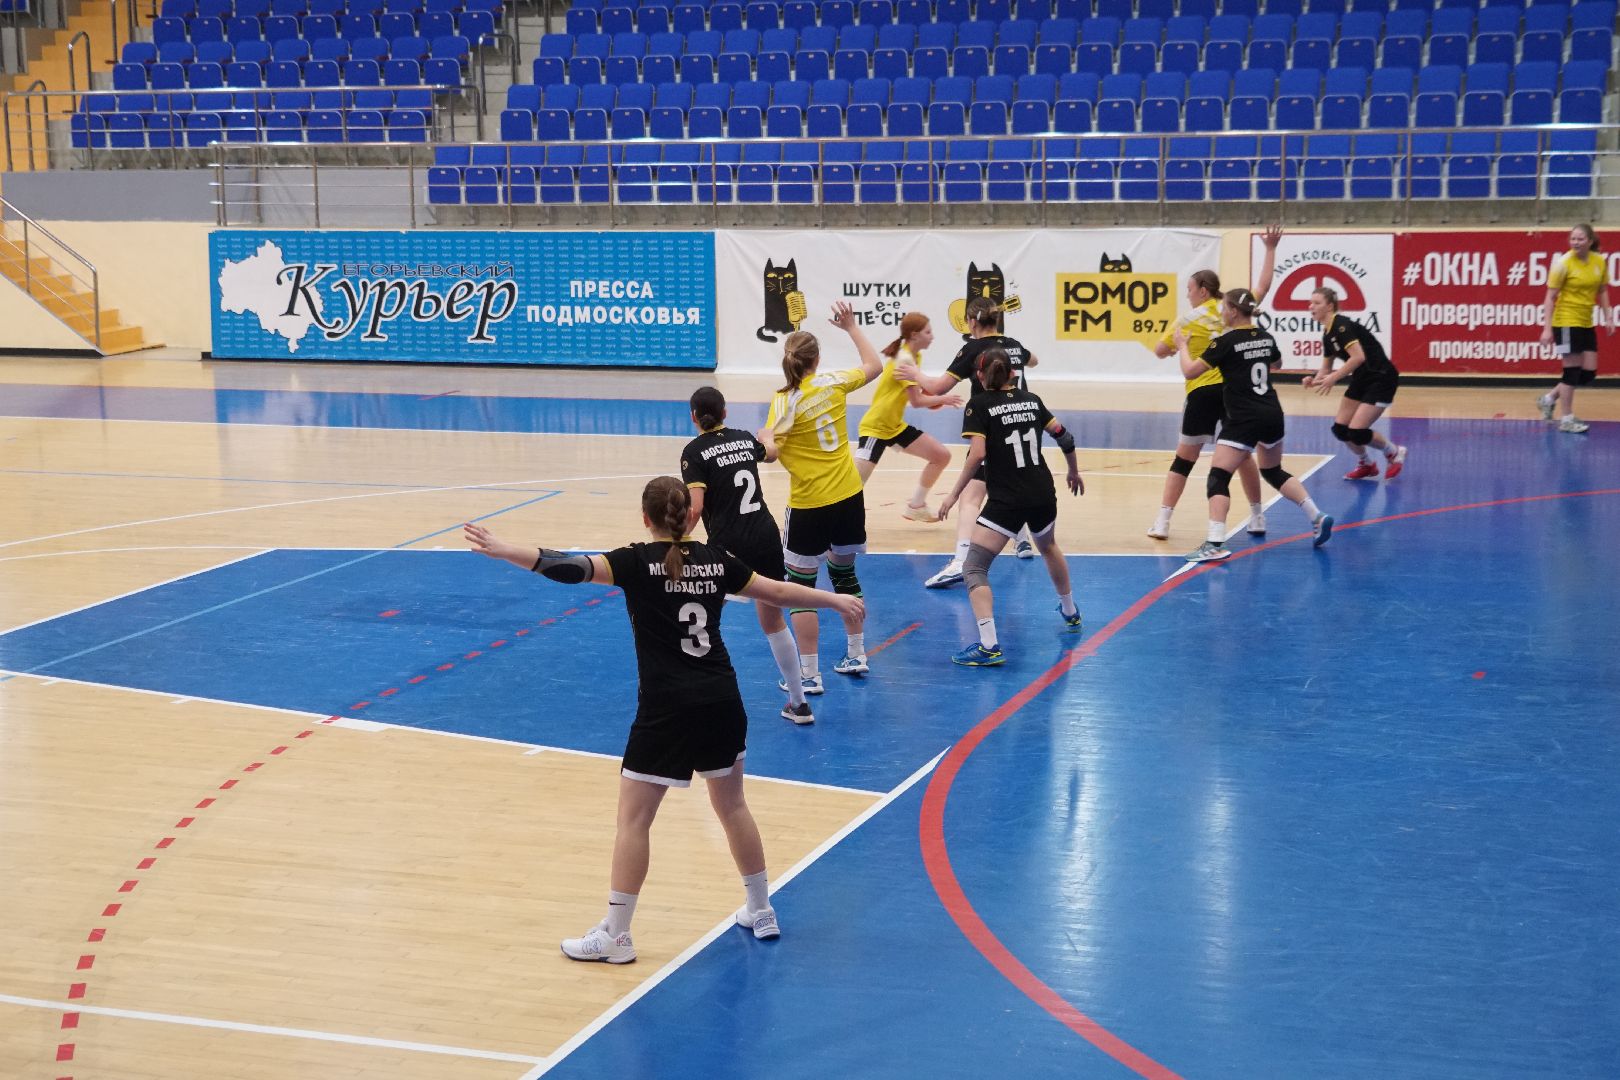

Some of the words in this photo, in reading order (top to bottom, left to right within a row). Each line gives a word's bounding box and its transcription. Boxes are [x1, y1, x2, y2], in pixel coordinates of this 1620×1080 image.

[342, 261, 514, 278] ЕГОРЬЕВСКИЙ
[1402, 252, 1500, 286] #ОКНА
[570, 280, 654, 299] ПРЕССА
[843, 282, 911, 297] ШУТКИ
[1064, 281, 1169, 314] ЮМОР
[276, 264, 518, 342] Курьер
[1401, 297, 1546, 330] Проверенное
[527, 305, 700, 327] ПОДМОСКОВЬЯ
[853, 310, 906, 326] ПЕ-СН
[1064, 310, 1112, 333] FM
[1133, 320, 1169, 333] 89.7
[1250, 362, 1269, 396] 9
[988, 402, 1039, 417] МОСКОВСКАЯ
[1001, 412, 1036, 425] ОБЛАСТЬ
[700, 439, 755, 461] МОСКОВСКАЯ
[716, 450, 754, 467] ОБЛАСТЬ
[1004, 427, 1040, 468] 11
[733, 469, 761, 514] 2
[648, 562, 725, 578] МООВСКАЯ
[664, 579, 718, 594] ОБЛАСТЬ
[678, 602, 712, 658] 3
